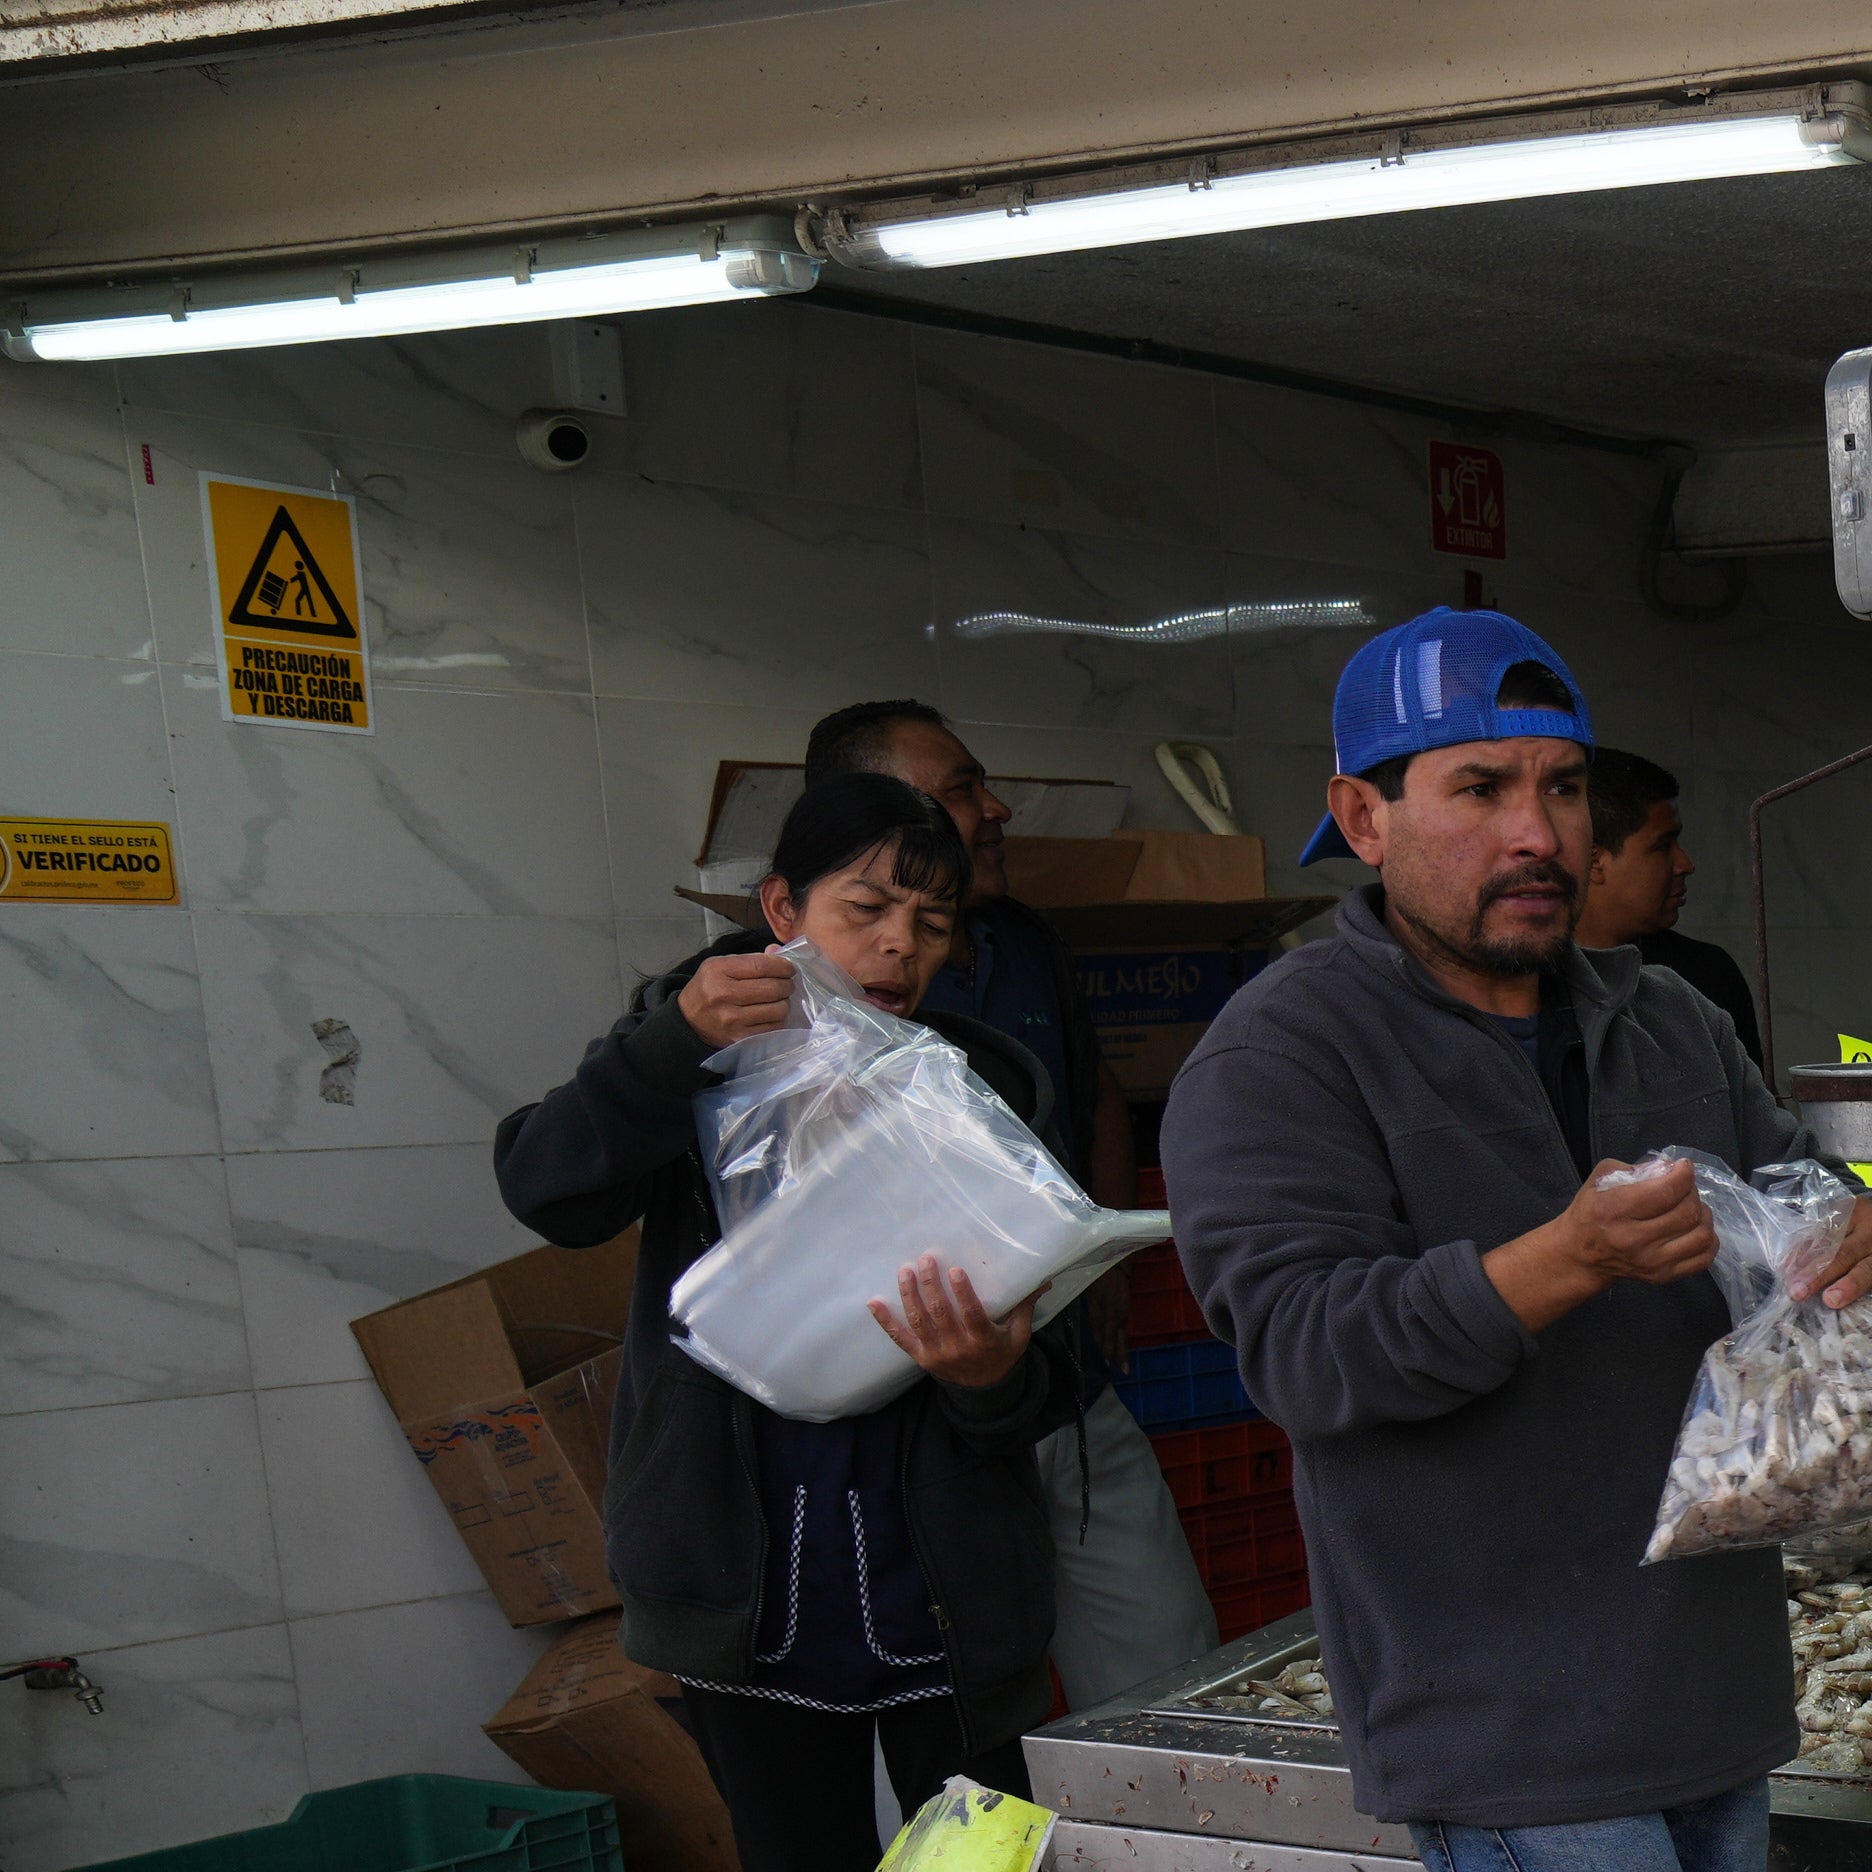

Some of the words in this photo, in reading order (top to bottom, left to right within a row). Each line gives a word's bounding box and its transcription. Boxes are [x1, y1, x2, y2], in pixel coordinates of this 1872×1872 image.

[1447, 526, 1493, 551] EXTINTOR
[241, 646, 351, 679] PRECAUCIÓN
[233, 668, 279, 693] ZONA
[282, 673, 304, 696] DE
[307, 677, 364, 702] CARGA
[248, 693, 259, 714] Y
[263, 694, 354, 723] DESCARGA
[14, 833, 28, 843] SI
[31, 834, 69, 845] TIENE
[72, 836, 86, 846] EL
[89, 837, 124, 847] SELLO
[128, 836, 158, 848] ESTÁ
[16, 850, 161, 873] VERIFICADO
